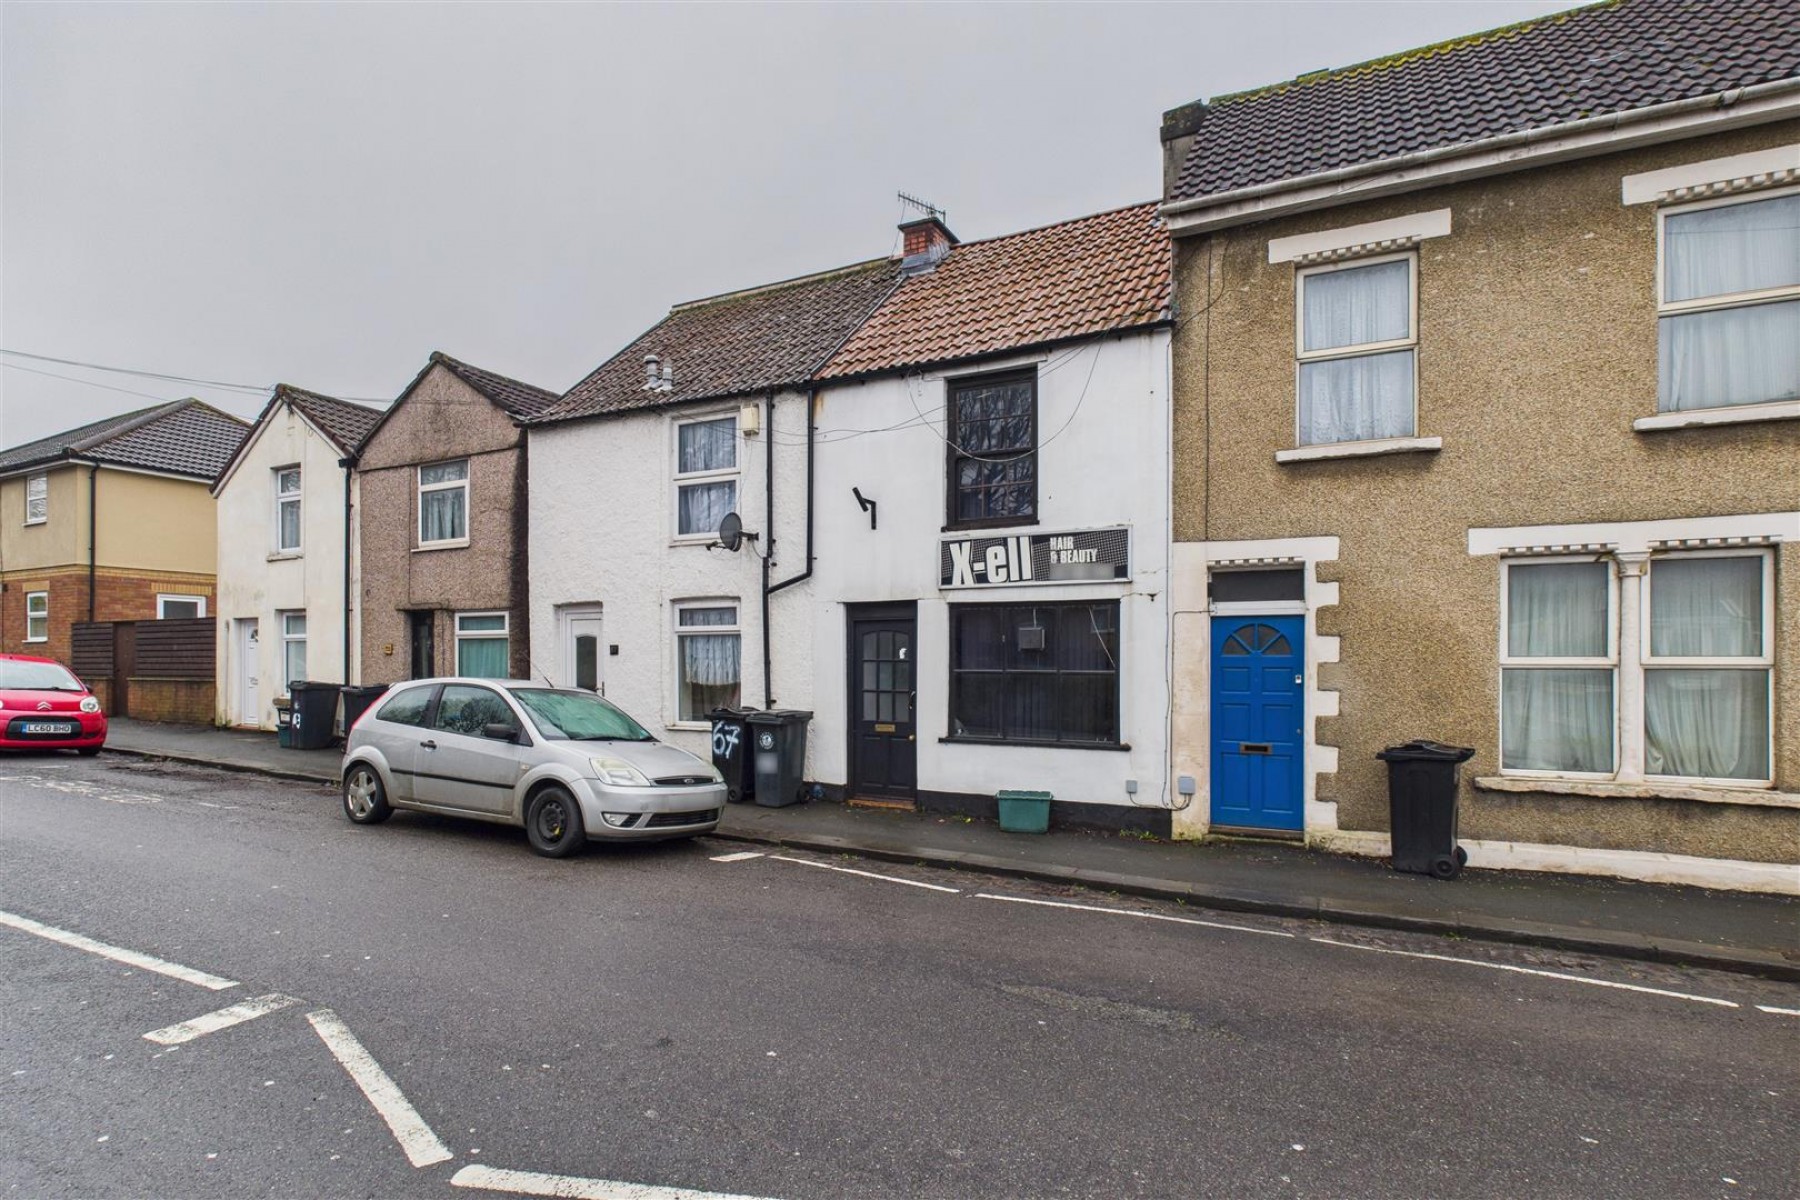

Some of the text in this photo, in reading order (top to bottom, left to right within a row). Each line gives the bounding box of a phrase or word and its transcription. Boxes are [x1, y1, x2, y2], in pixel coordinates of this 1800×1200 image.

[1050, 536, 1074, 550] HAIR
[950, 537, 1032, 586] X-ell
[1050, 549, 1097, 563] & BEAUTY
[28, 724, 52, 732] LC60
[712, 720, 740, 759] 67
